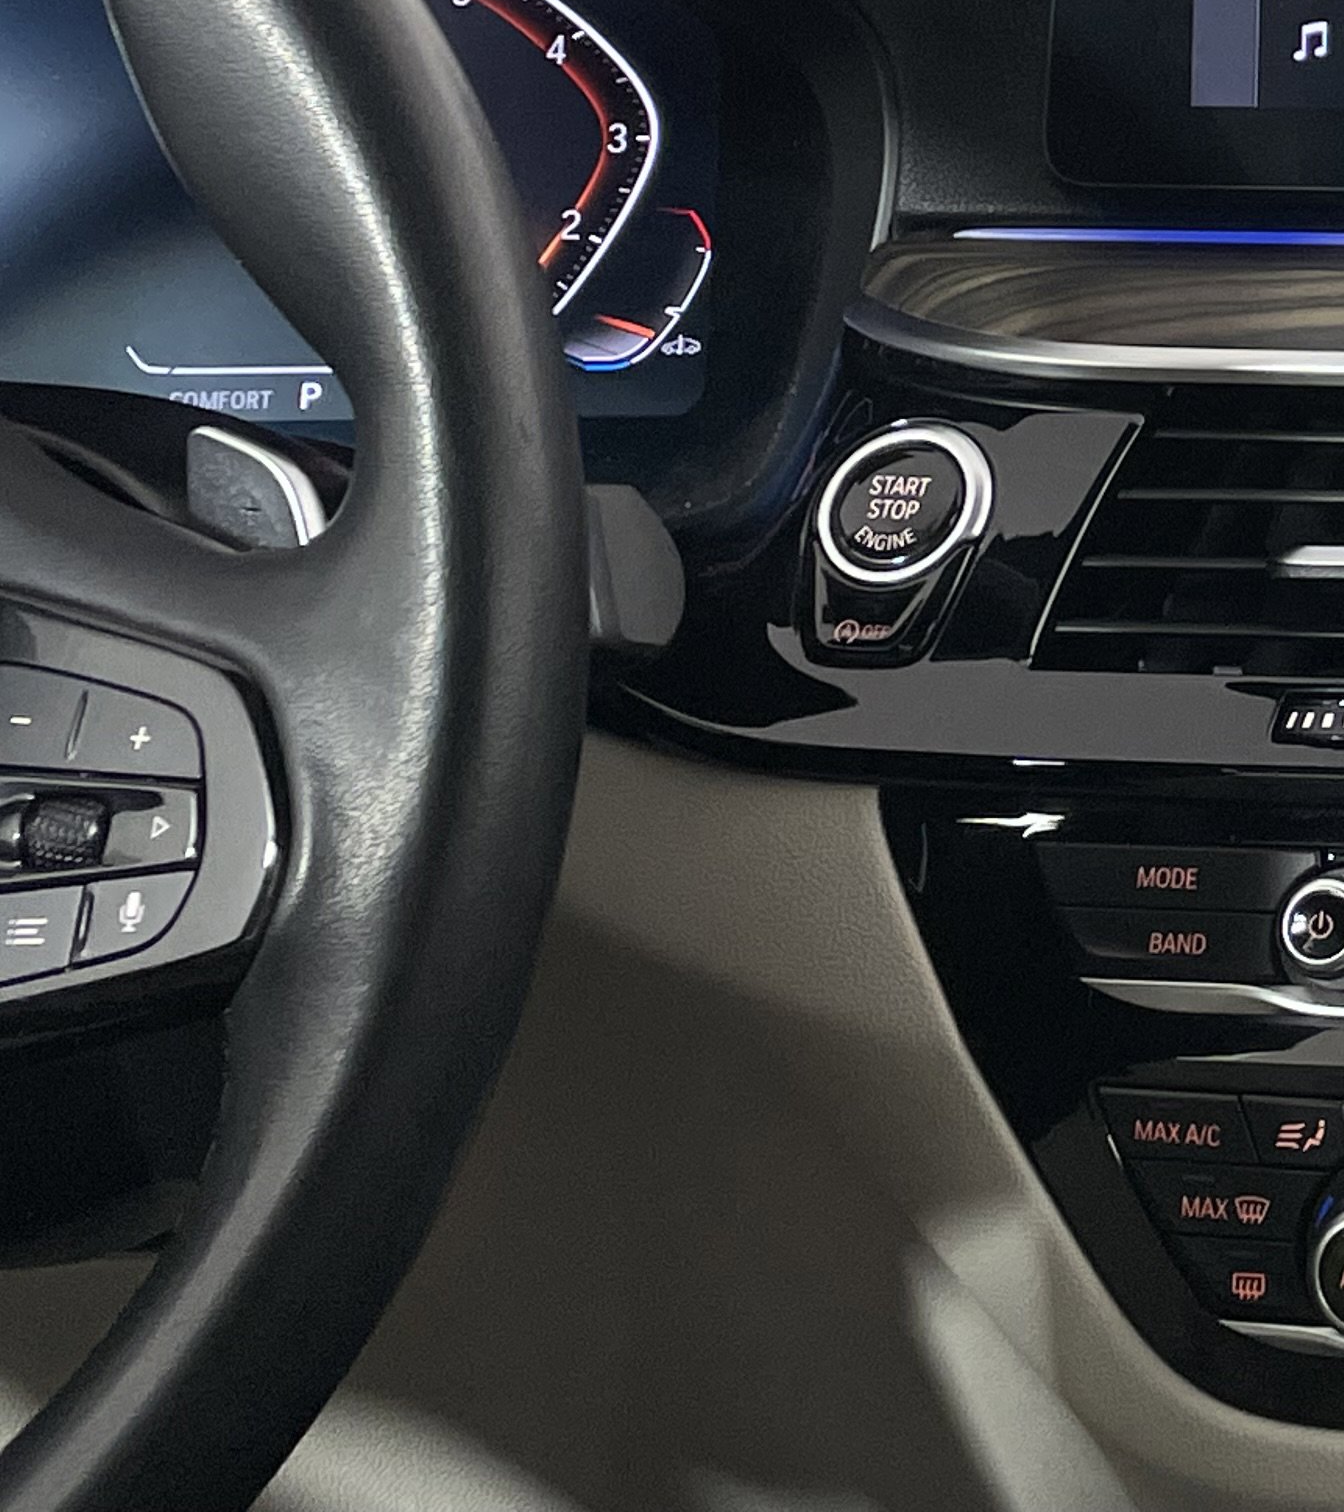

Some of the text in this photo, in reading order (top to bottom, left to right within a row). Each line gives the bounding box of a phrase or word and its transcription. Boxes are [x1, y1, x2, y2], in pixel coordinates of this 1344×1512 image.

[542, 34, 567, 67] 4
[603, 119, 628, 157] 3
[557, 207, 583, 243] 2
[299, 381, 323, 410] P
[868, 474, 932, 497] START
[866, 498, 920, 520] STOP
[853, 525, 918, 551] ENGINE
[1136, 866, 1198, 890] MODE
[1148, 932, 1207, 955] BAND
[1134, 1119, 1220, 1147] MAX A/C
[1181, 1195, 1229, 1220] MAX
